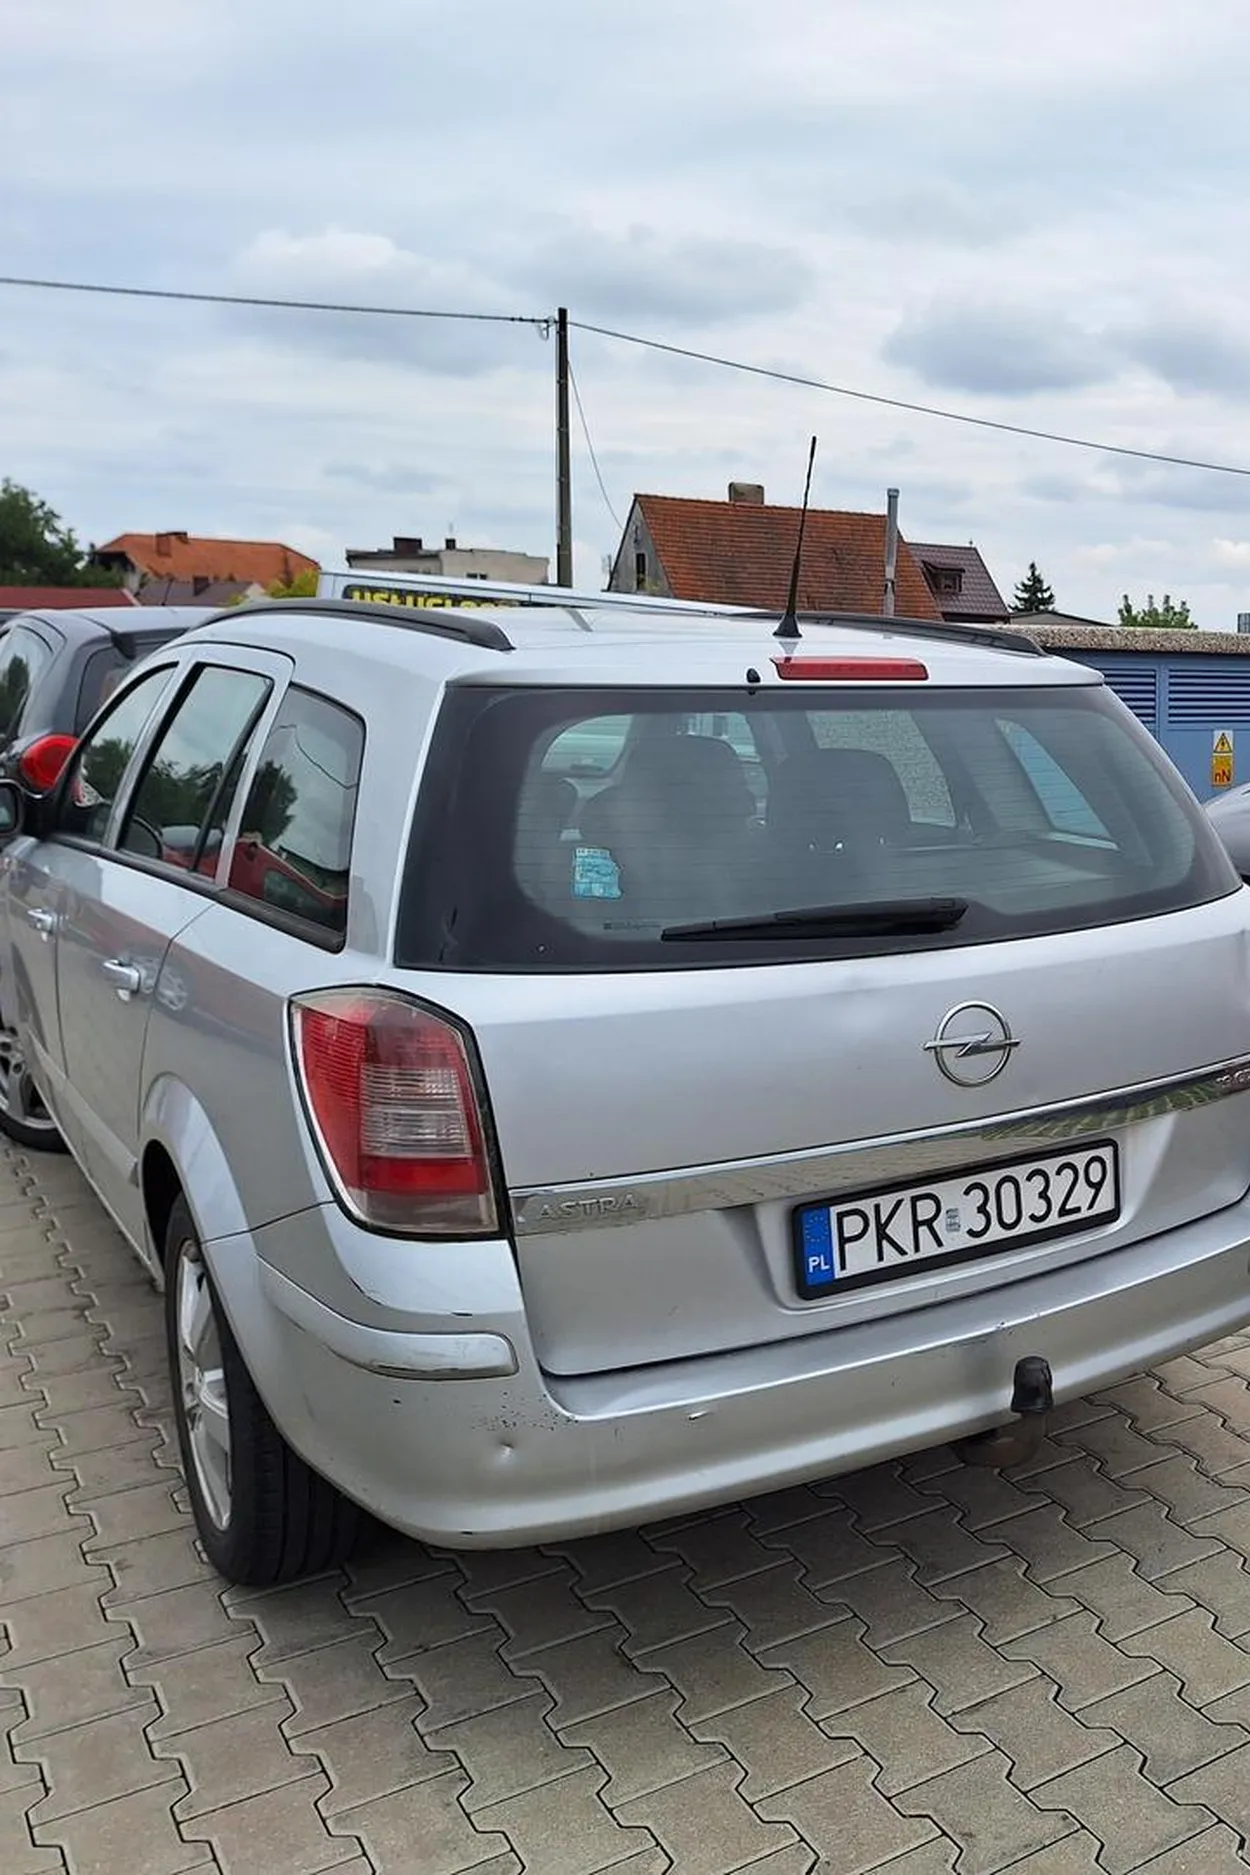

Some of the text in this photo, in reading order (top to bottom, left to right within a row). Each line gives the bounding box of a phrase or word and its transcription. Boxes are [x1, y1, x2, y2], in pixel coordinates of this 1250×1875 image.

[541, 1194, 640, 1219] ASTRA
[835, 1154, 1108, 1272] PKR 30329
[808, 1255, 831, 1274] PL
